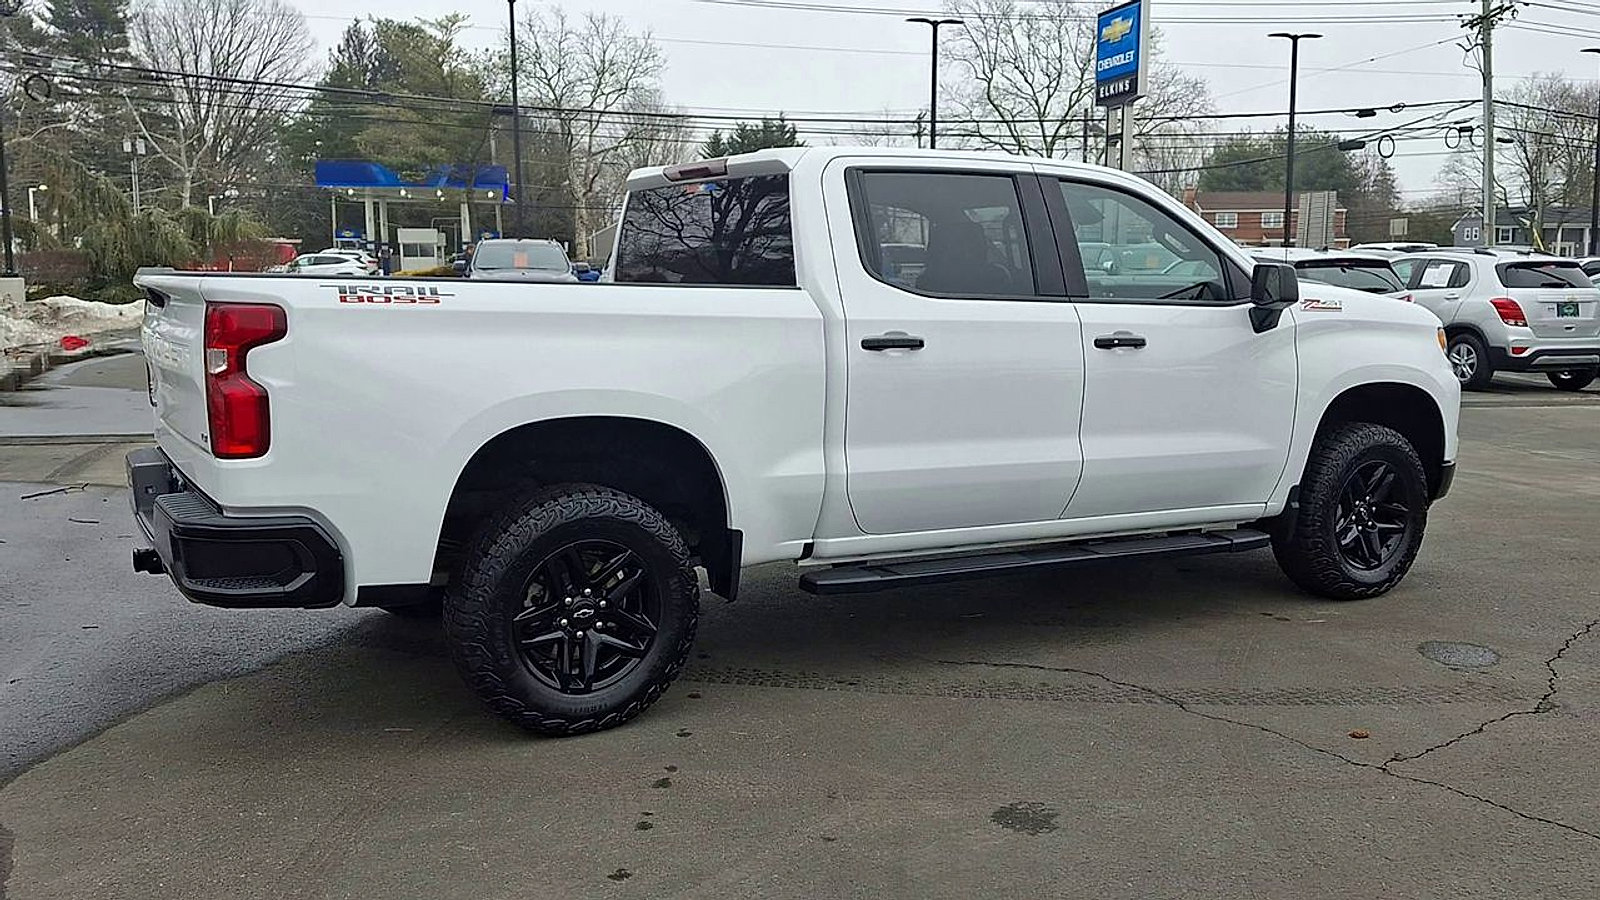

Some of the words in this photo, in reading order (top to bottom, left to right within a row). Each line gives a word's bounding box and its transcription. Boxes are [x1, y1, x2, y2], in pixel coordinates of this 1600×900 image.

[1100, 80, 1130, 98] ELKINS
[319, 284, 456, 296] TRAIL
[339, 295, 441, 304] BOSS
